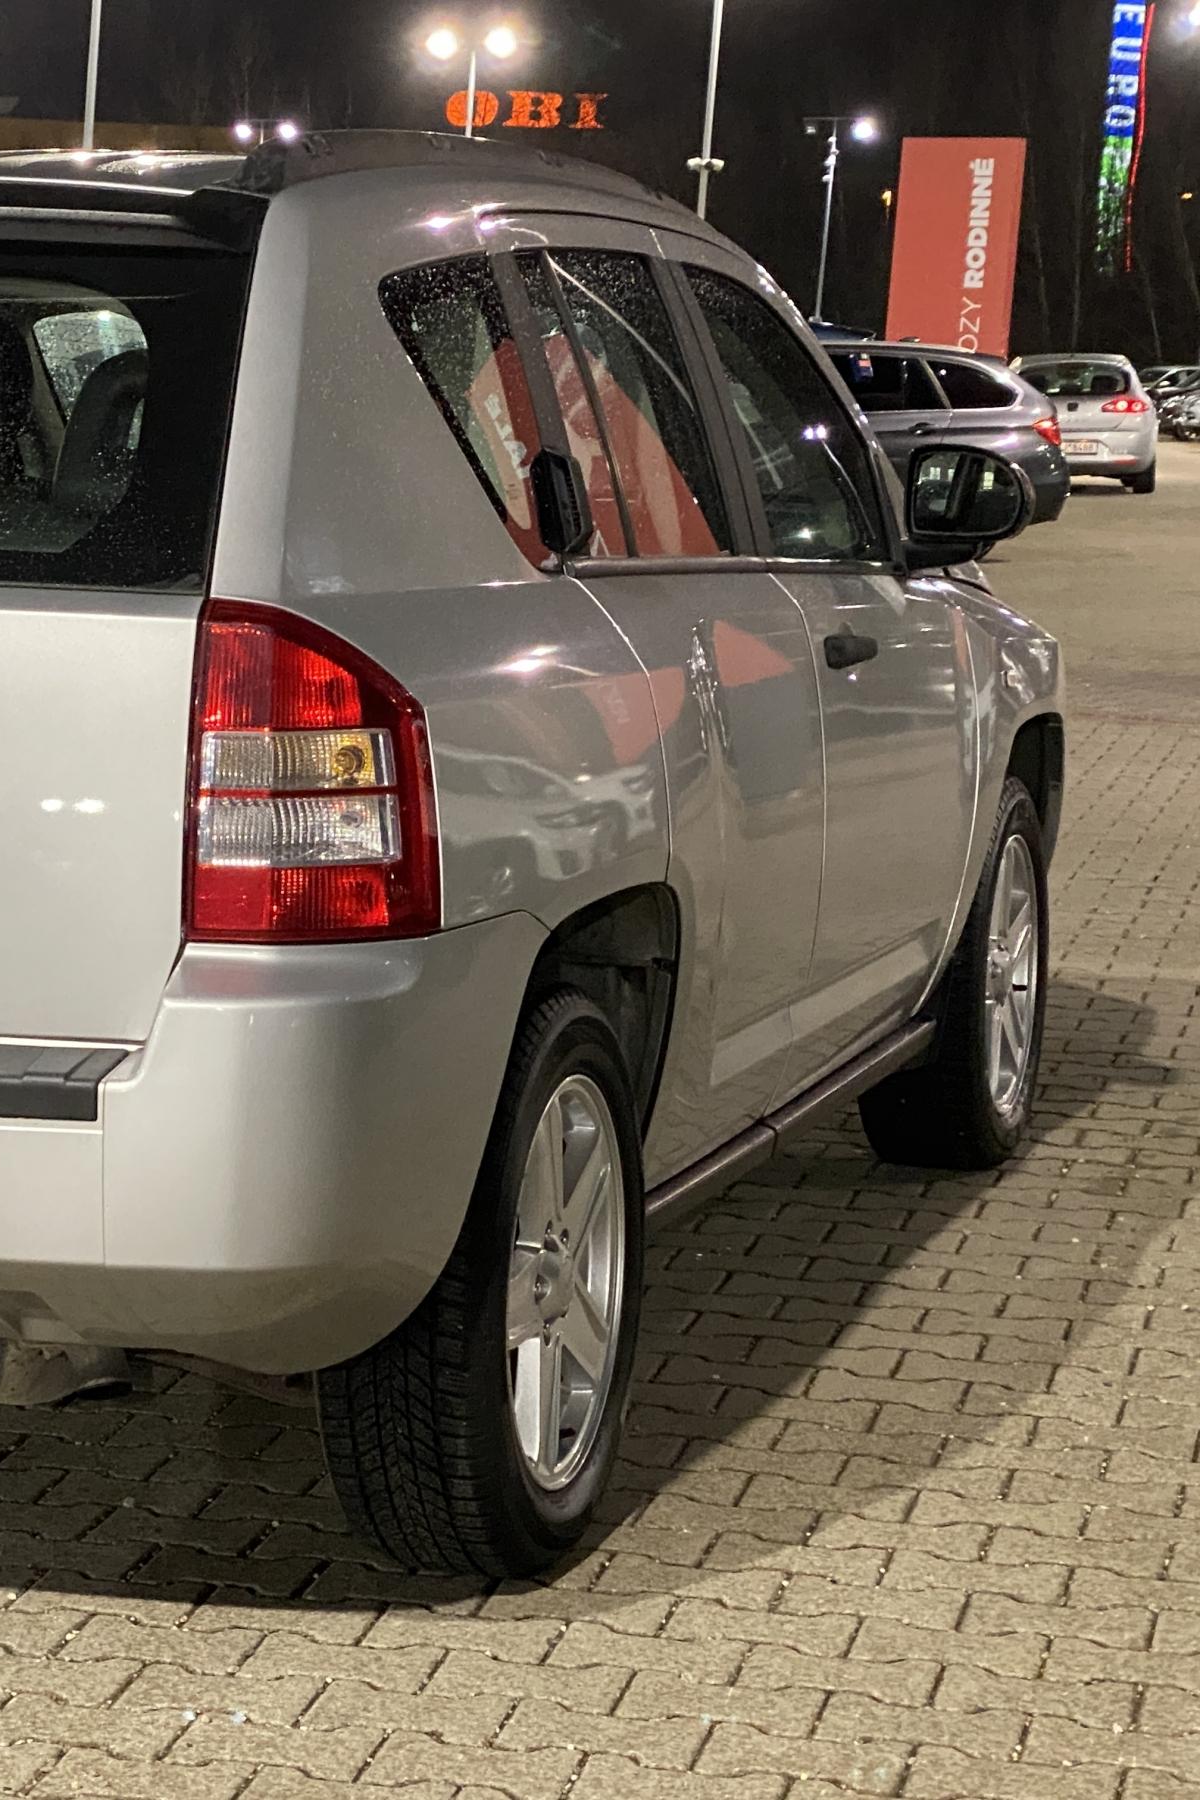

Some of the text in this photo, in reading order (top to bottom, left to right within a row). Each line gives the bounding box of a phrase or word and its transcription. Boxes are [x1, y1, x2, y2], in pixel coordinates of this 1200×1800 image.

[445, 89, 608, 129] OBI
[1105, 3, 1146, 127] EURO
[958, 157, 995, 353] OZY RODINNÉ
